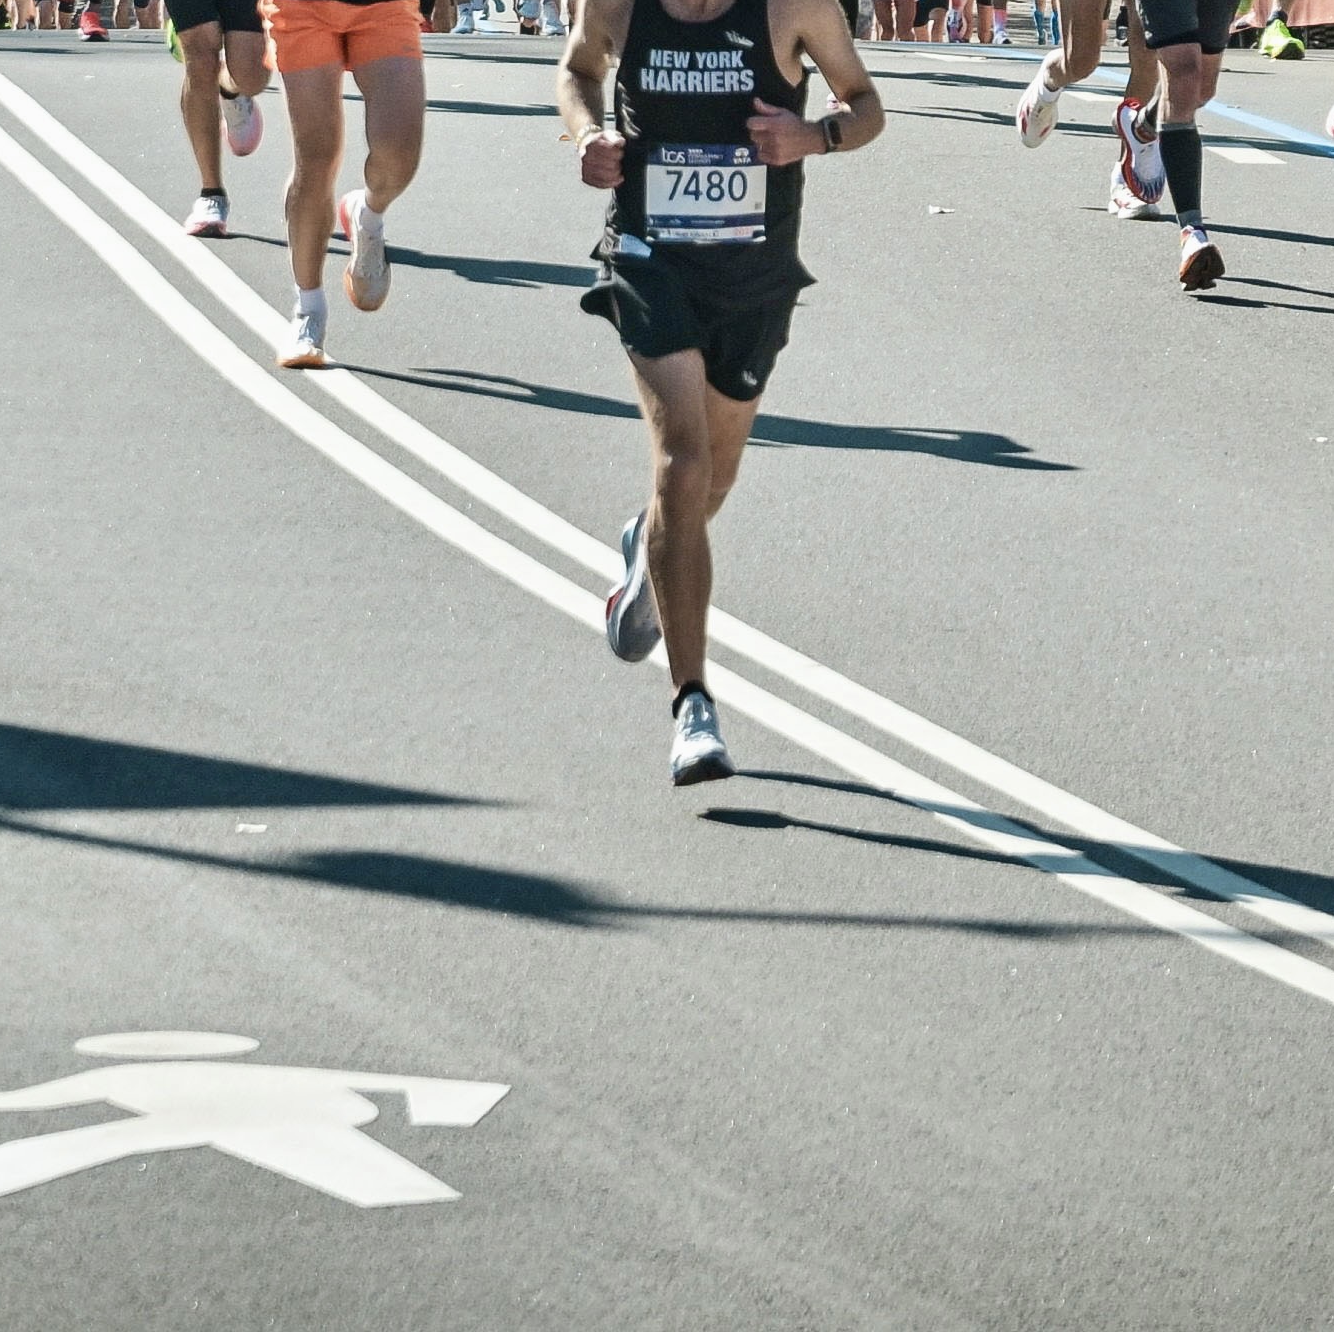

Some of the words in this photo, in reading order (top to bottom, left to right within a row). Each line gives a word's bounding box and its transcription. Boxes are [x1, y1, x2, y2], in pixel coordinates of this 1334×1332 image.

[649, 49, 690, 68] NEW
[695, 50, 744, 69] YORK
[640, 68, 755, 93] HARRIERS
[661, 147, 686, 165] tcs
[666, 169, 748, 203] 7480
